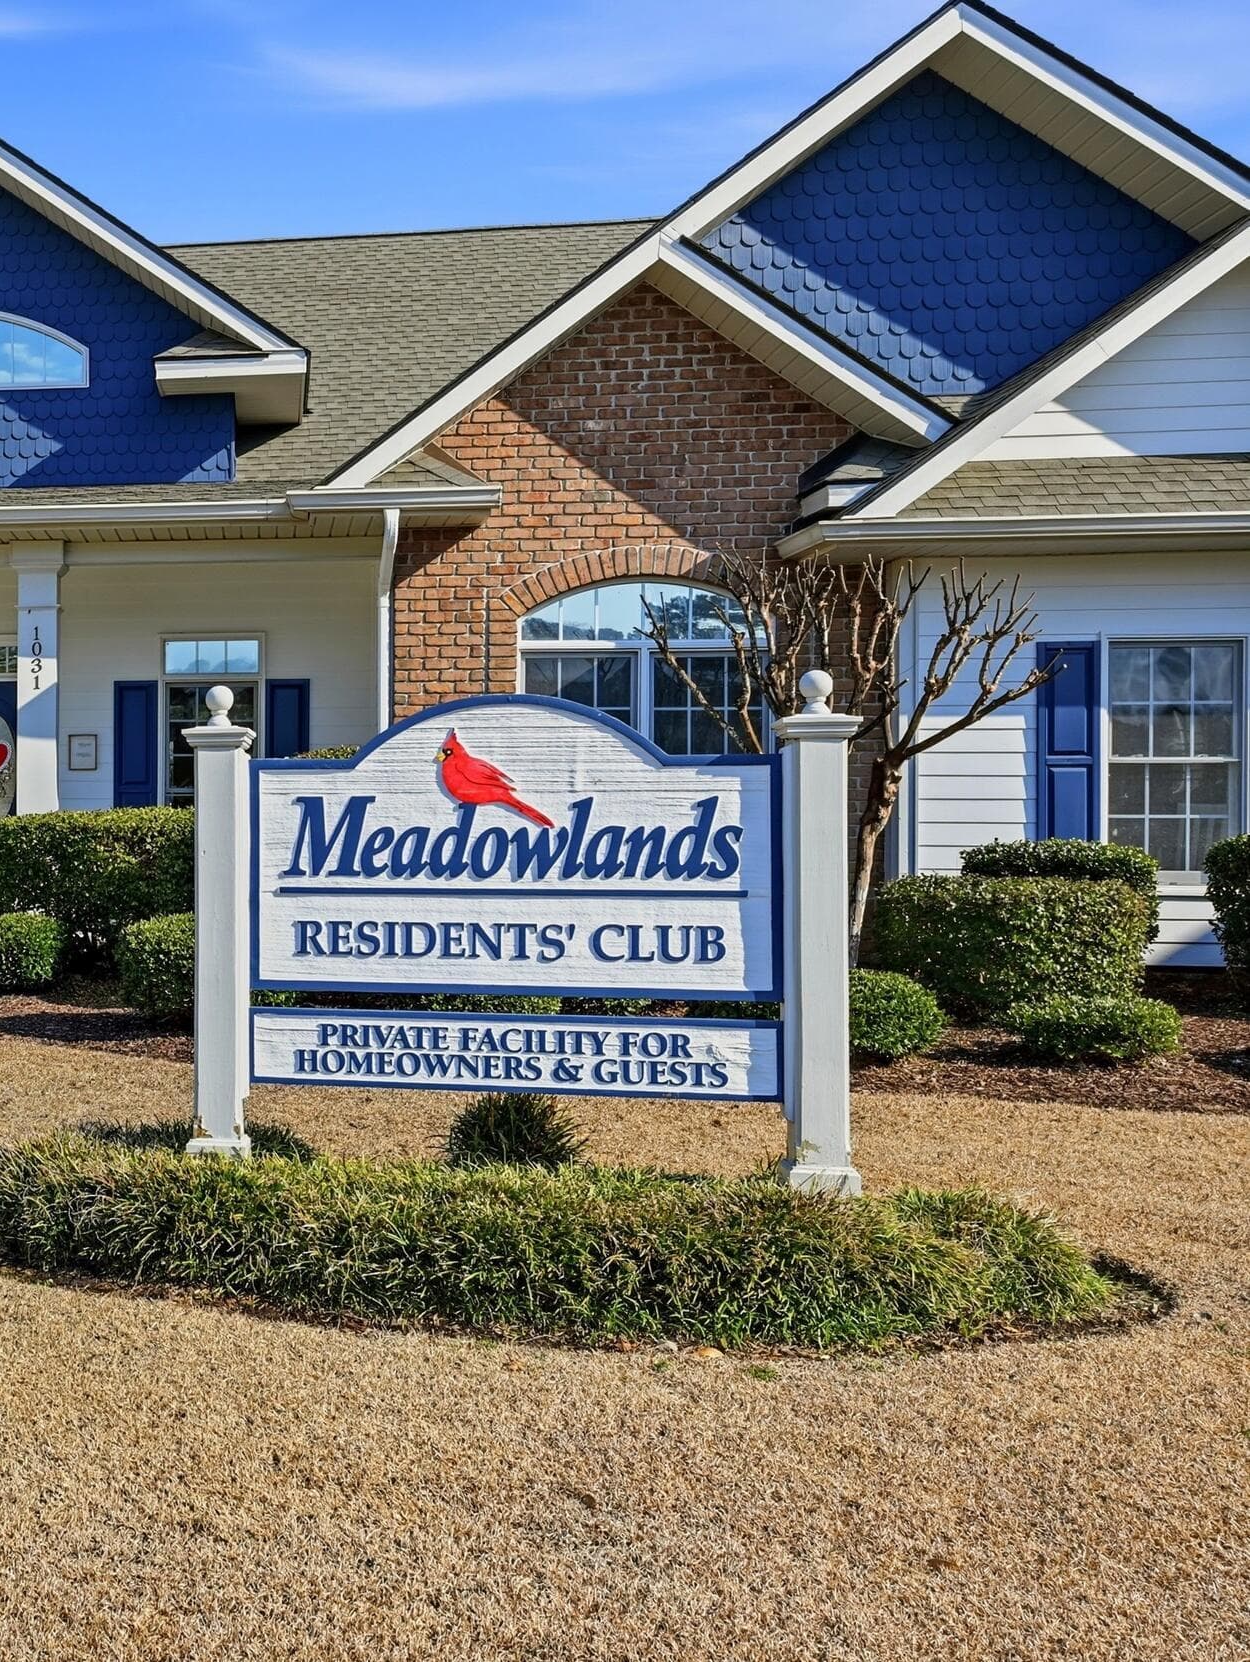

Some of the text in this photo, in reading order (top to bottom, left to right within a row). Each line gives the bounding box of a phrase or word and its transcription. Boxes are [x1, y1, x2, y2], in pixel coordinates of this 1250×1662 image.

[30, 626, 43, 690] 1031
[282, 795, 744, 880] Meadowlands
[591, 923, 727, 964] CLUB
[318, 1023, 694, 1059] PRIVATE FACILITY FOR
[297, 1049, 729, 1089] HOMEOWNERS & GUESTS
